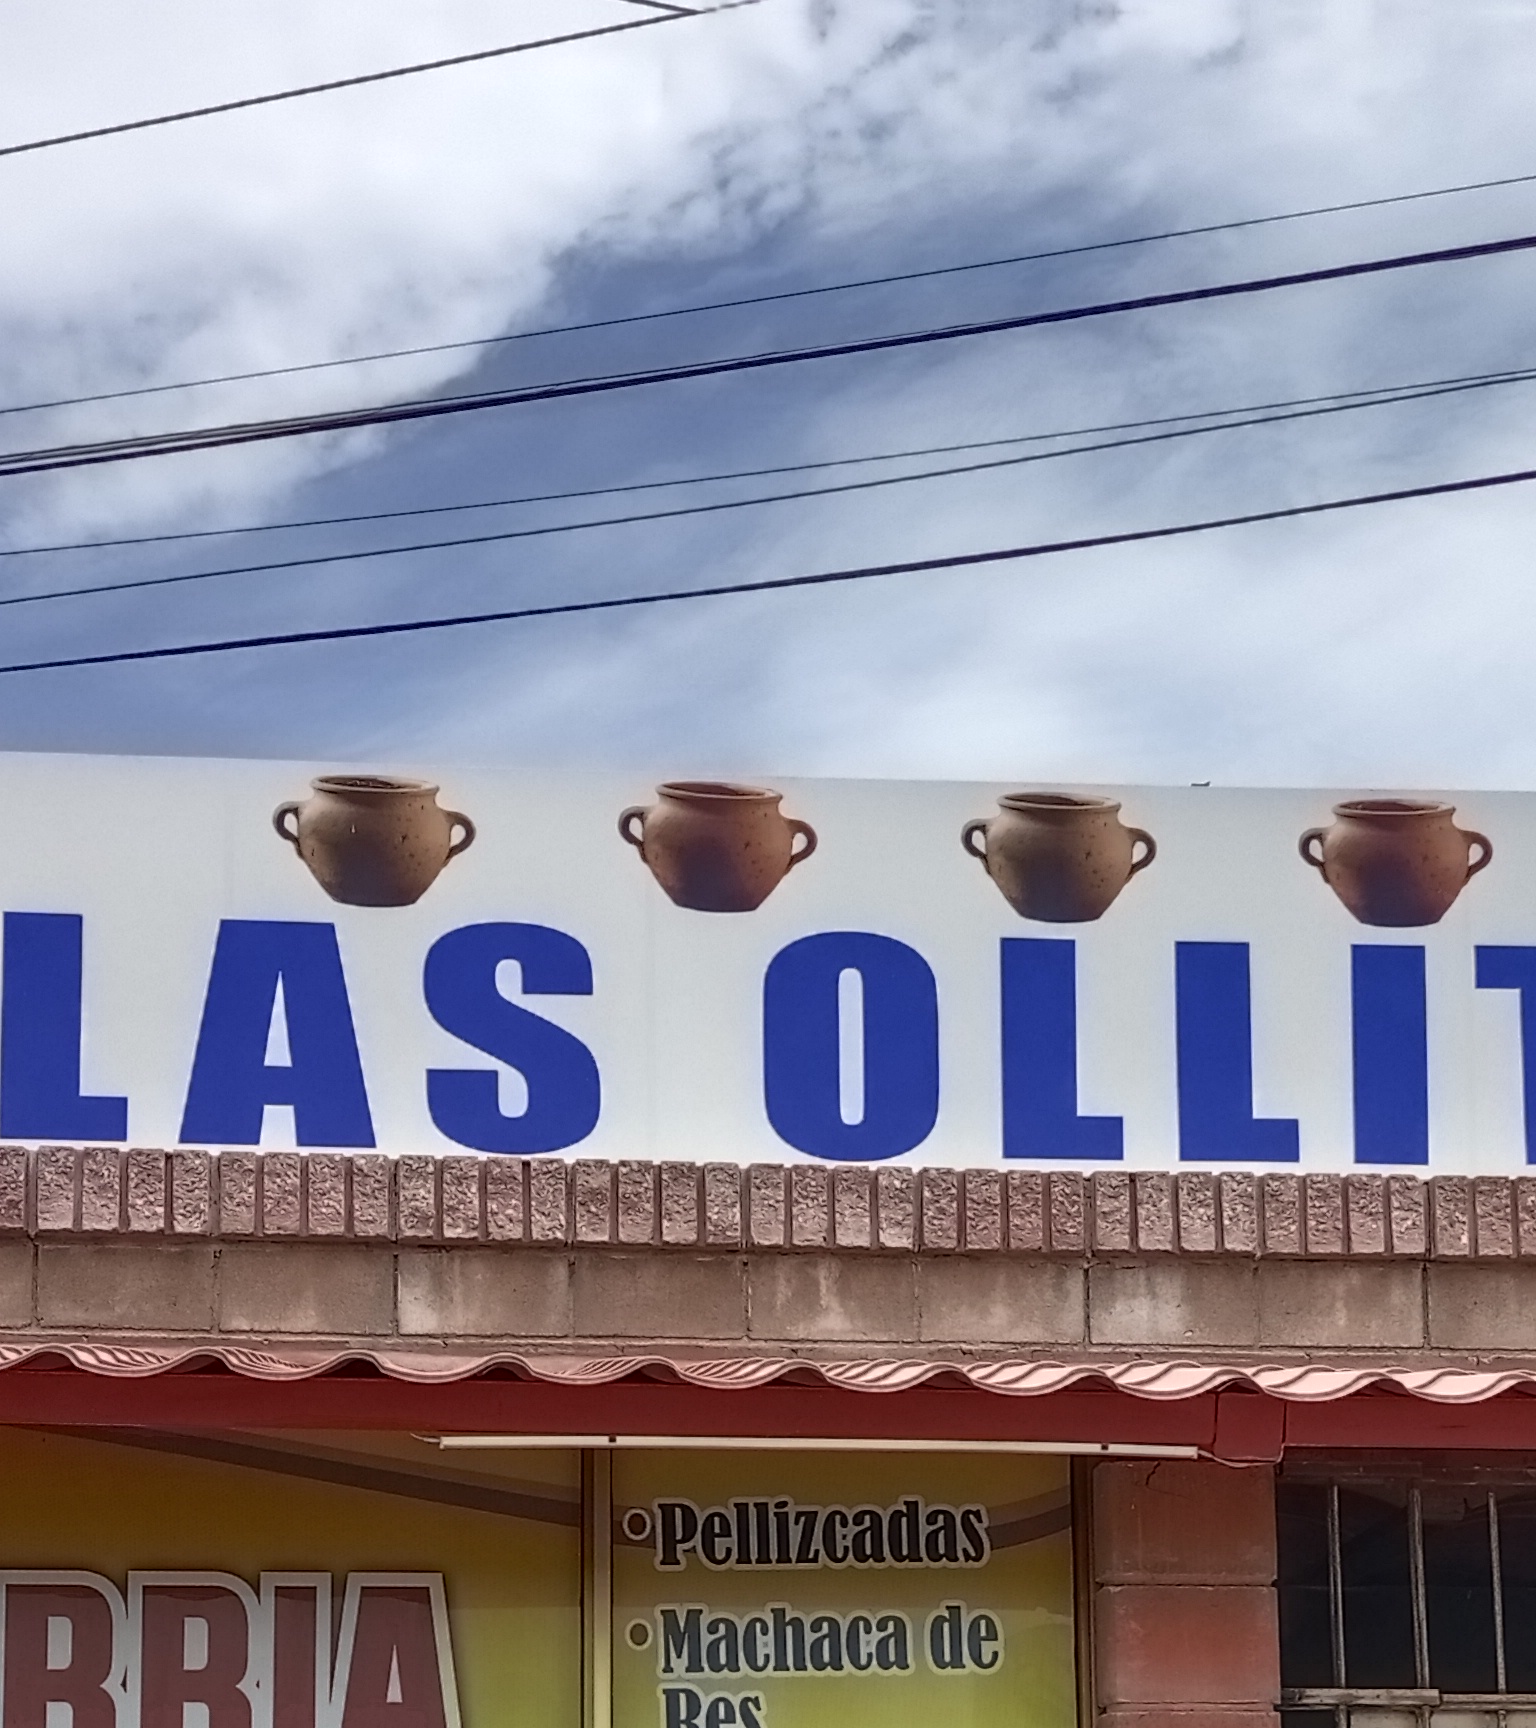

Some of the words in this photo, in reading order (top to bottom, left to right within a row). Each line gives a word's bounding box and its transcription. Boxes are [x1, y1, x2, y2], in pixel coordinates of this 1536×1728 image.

[1, 913, 599, 1152] LAS
[657, 1499, 988, 1567] Pellizcadas
[659, 1606, 911, 1674] Machaca
[929, 1604, 1001, 1670] de
